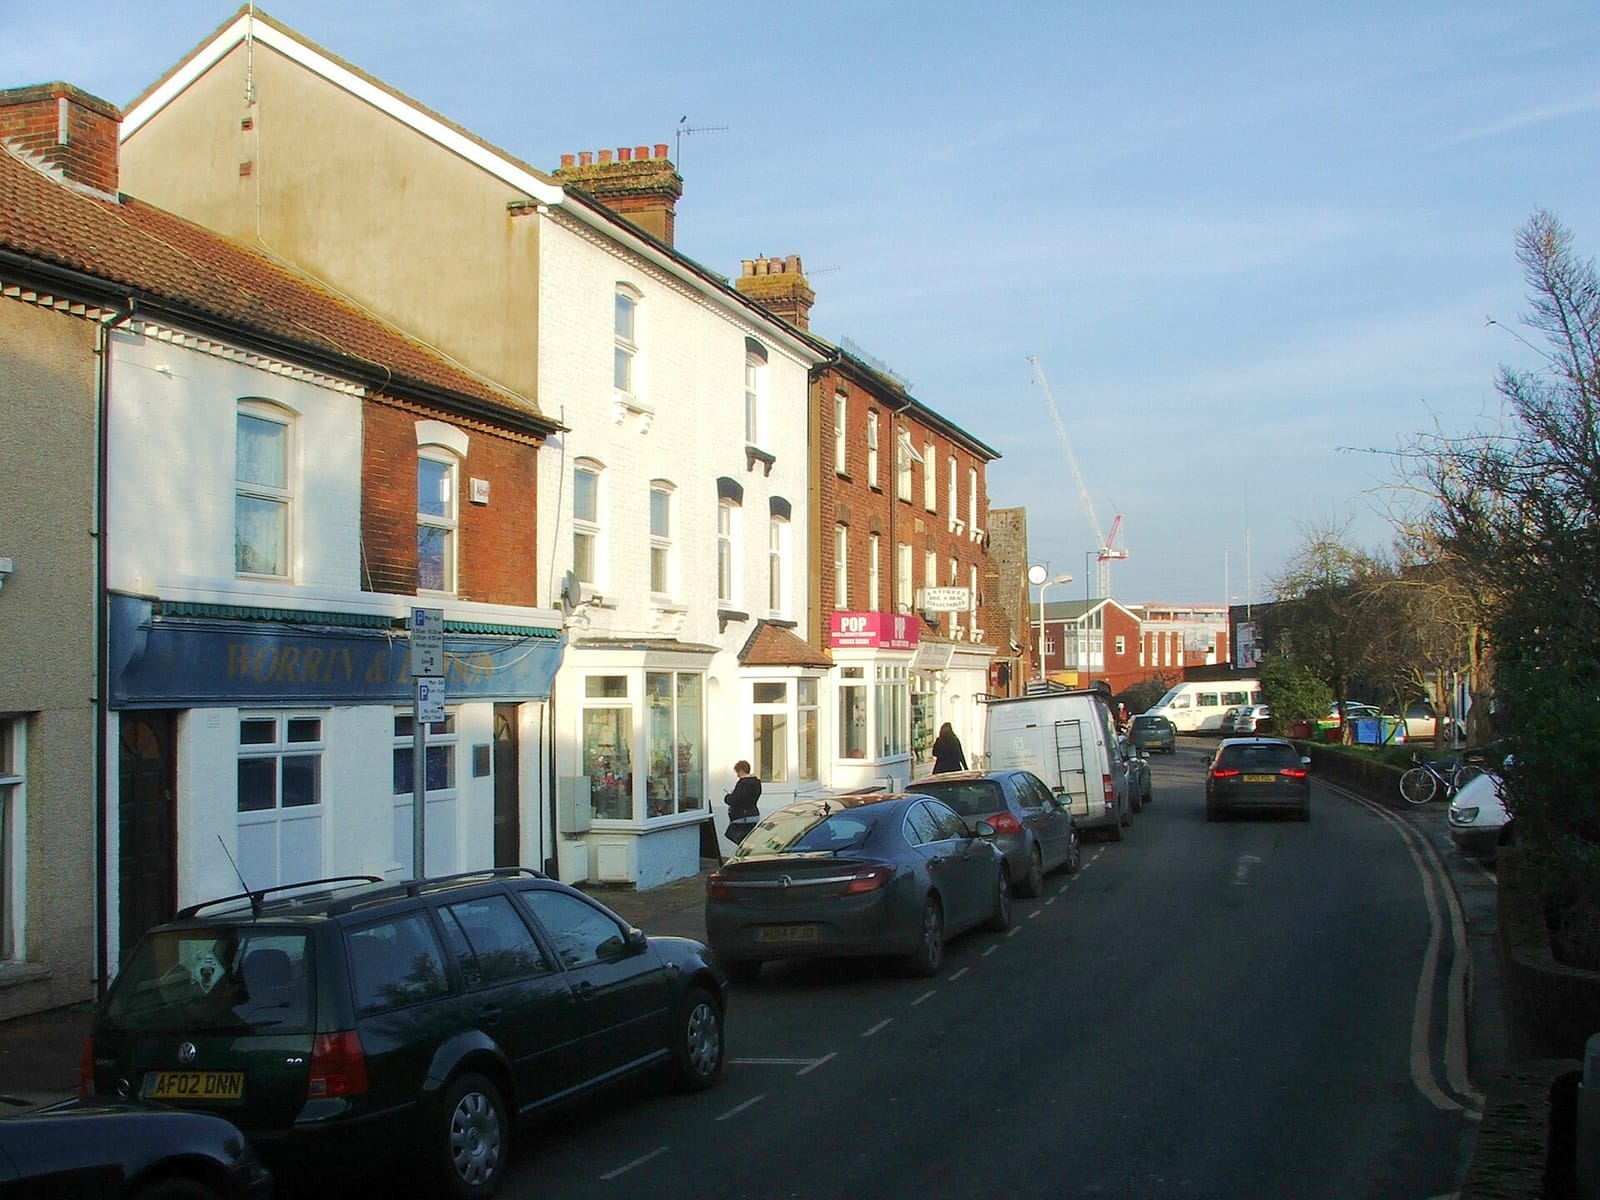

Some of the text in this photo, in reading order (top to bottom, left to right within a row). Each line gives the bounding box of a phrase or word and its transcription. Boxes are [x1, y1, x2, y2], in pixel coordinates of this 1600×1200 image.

[841, 617, 867, 632] POP
[364, 650, 387, 684] &
[156, 1071, 241, 1095] AF02 DNN
